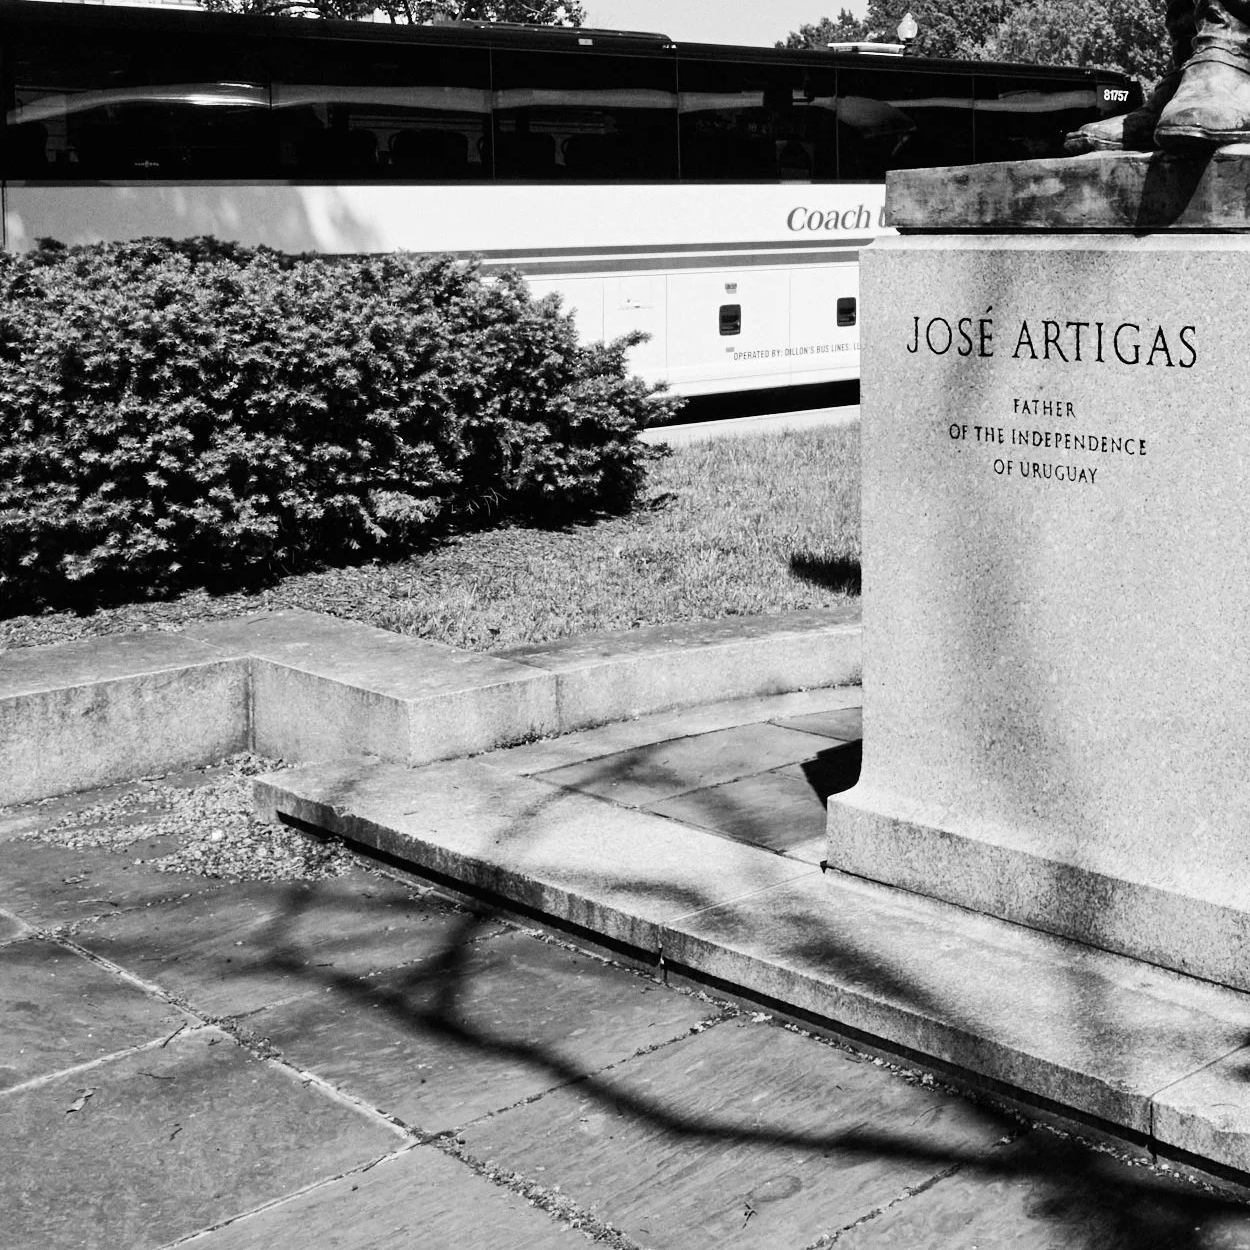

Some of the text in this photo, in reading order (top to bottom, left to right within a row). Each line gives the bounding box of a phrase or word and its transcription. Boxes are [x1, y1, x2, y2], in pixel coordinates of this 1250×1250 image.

[1103, 88, 1129, 102] 81757
[787, 204, 871, 232] Coach
[906, 305, 1197, 368] JOSÉ ARTIGAS
[733, 349, 770, 361] OPERATED
[784, 345, 815, 357] DILLON'S
[816, 344, 829, 354] BUS
[1013, 398, 1076, 418] FATHER
[949, 423, 1147, 456] OF THE INDEPENDENCE
[993, 459, 1098, 484] OF URUGUAY
